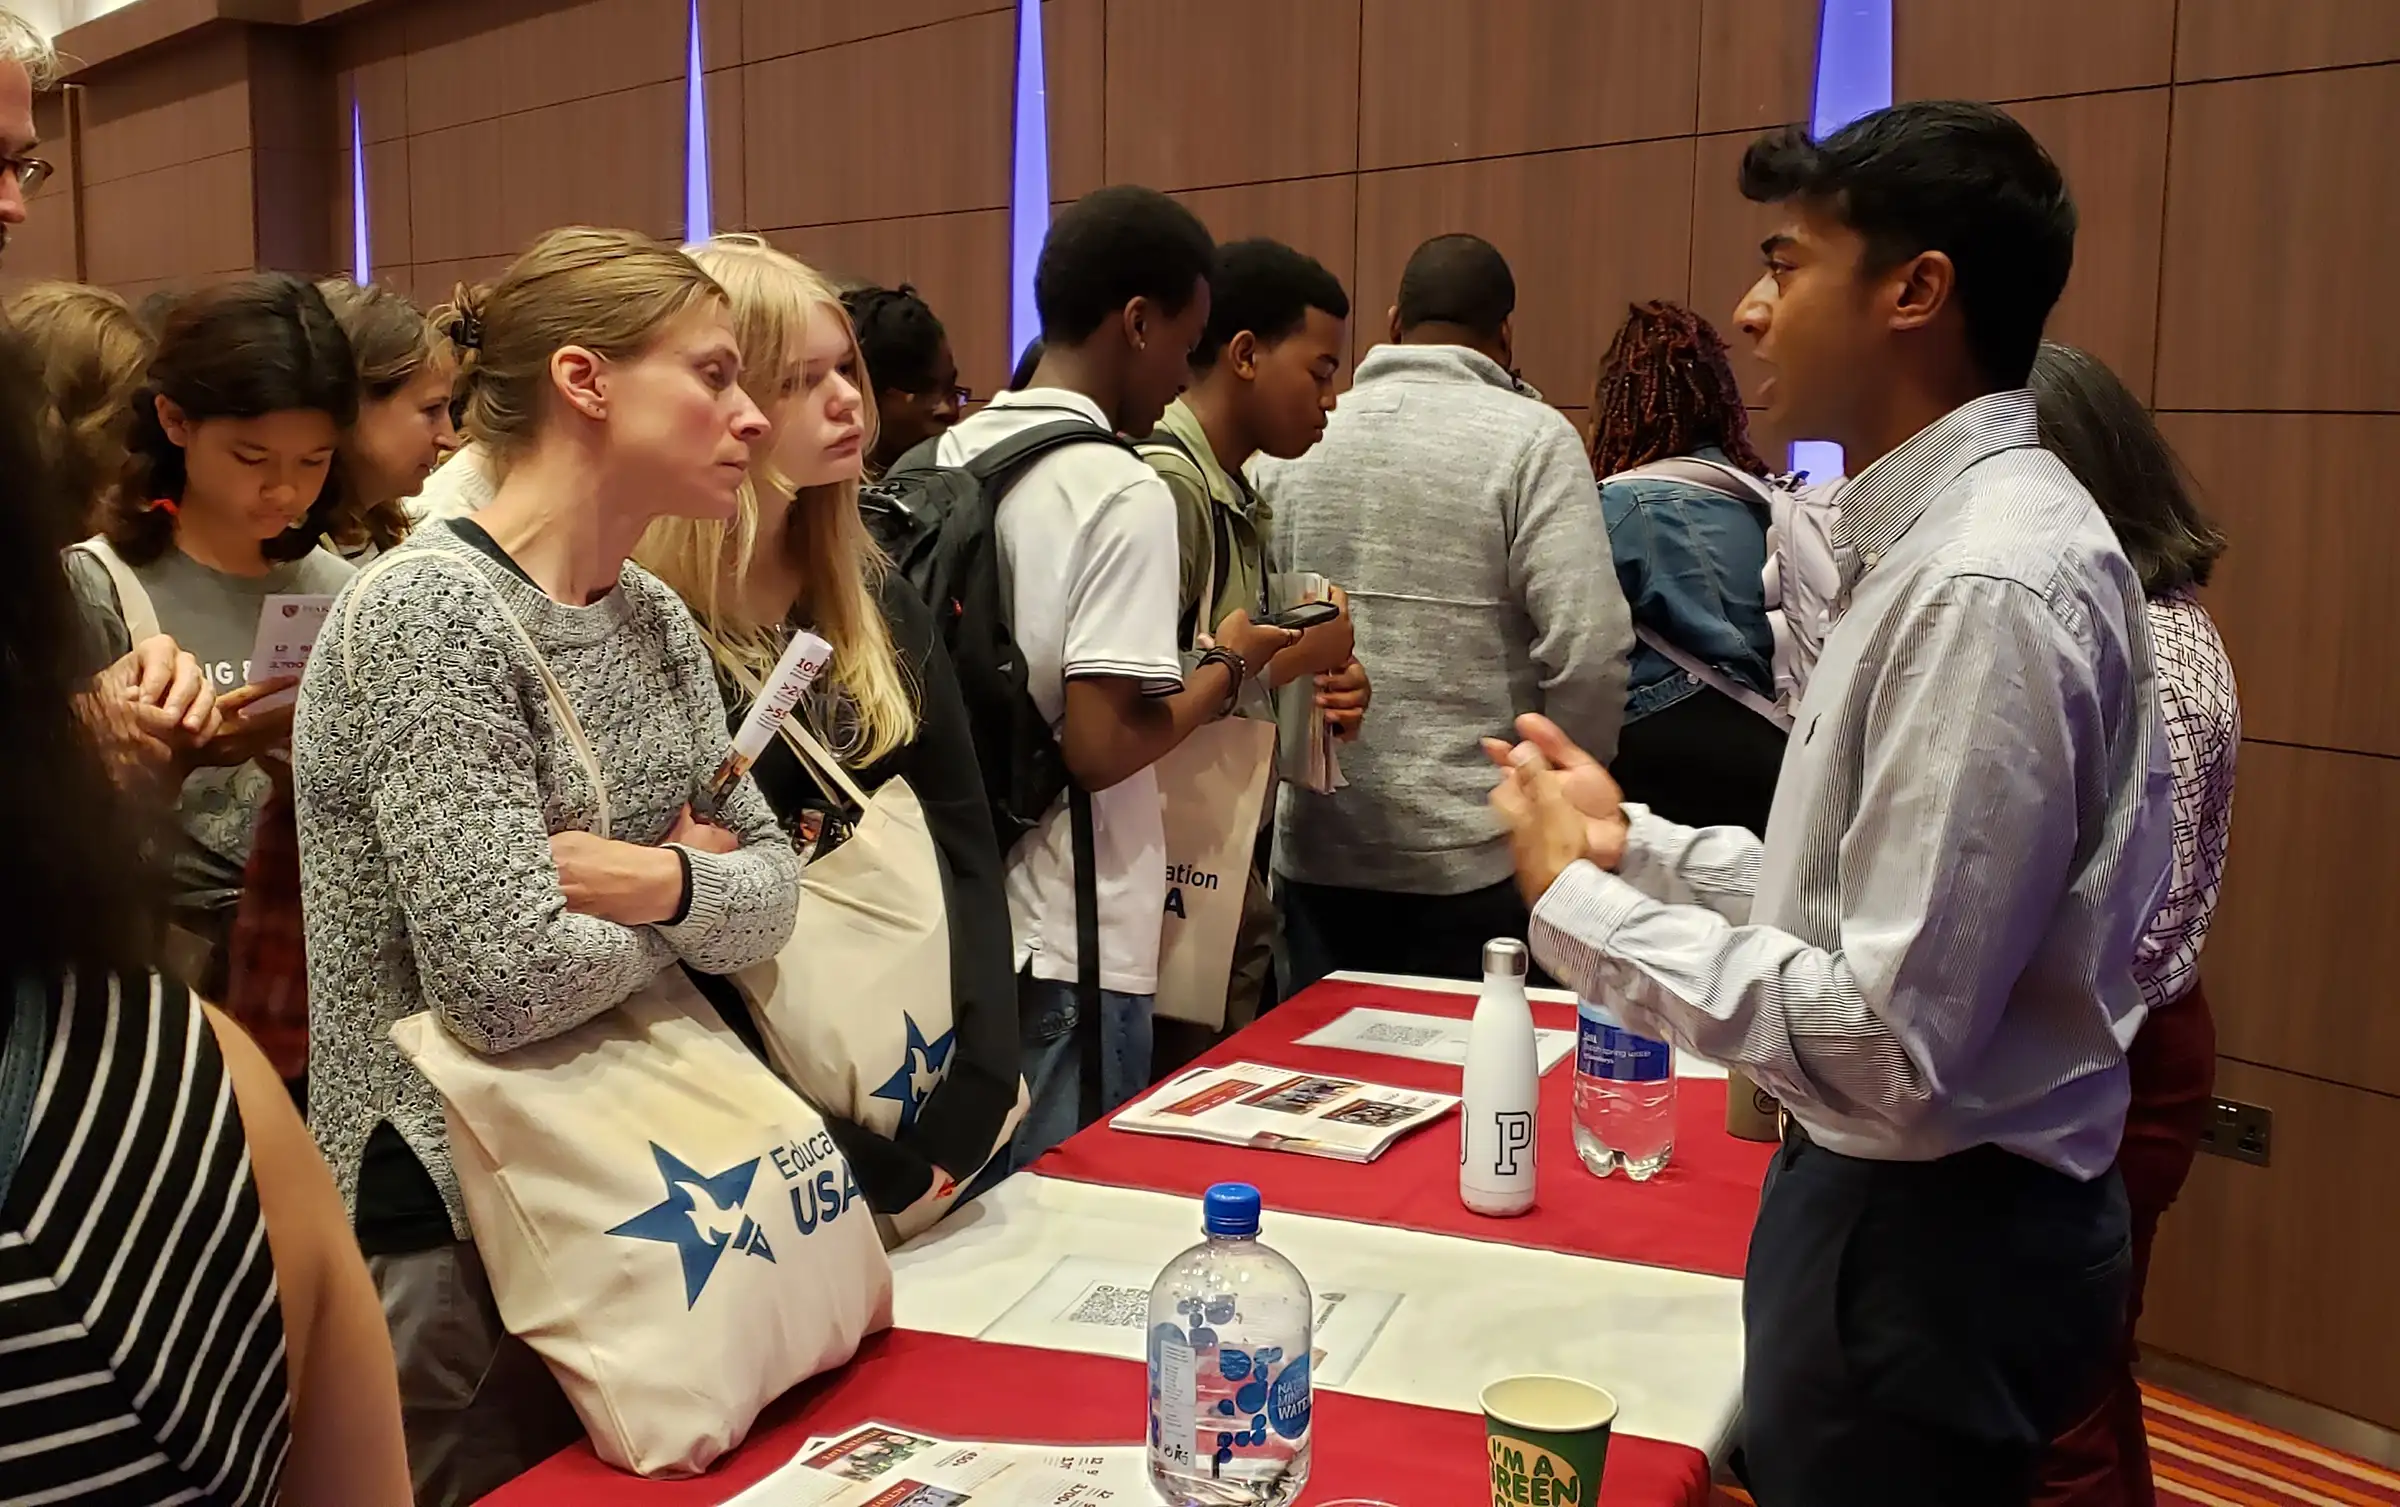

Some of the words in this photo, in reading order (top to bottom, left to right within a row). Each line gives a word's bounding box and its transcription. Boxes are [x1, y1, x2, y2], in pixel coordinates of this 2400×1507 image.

[769, 1131, 835, 1180] Educa
[790, 1158, 860, 1236] USA
[1278, 1396, 1311, 1421] WATE
[1492, 1437, 1525, 1474] I'M
[1533, 1454, 1555, 1478] A
